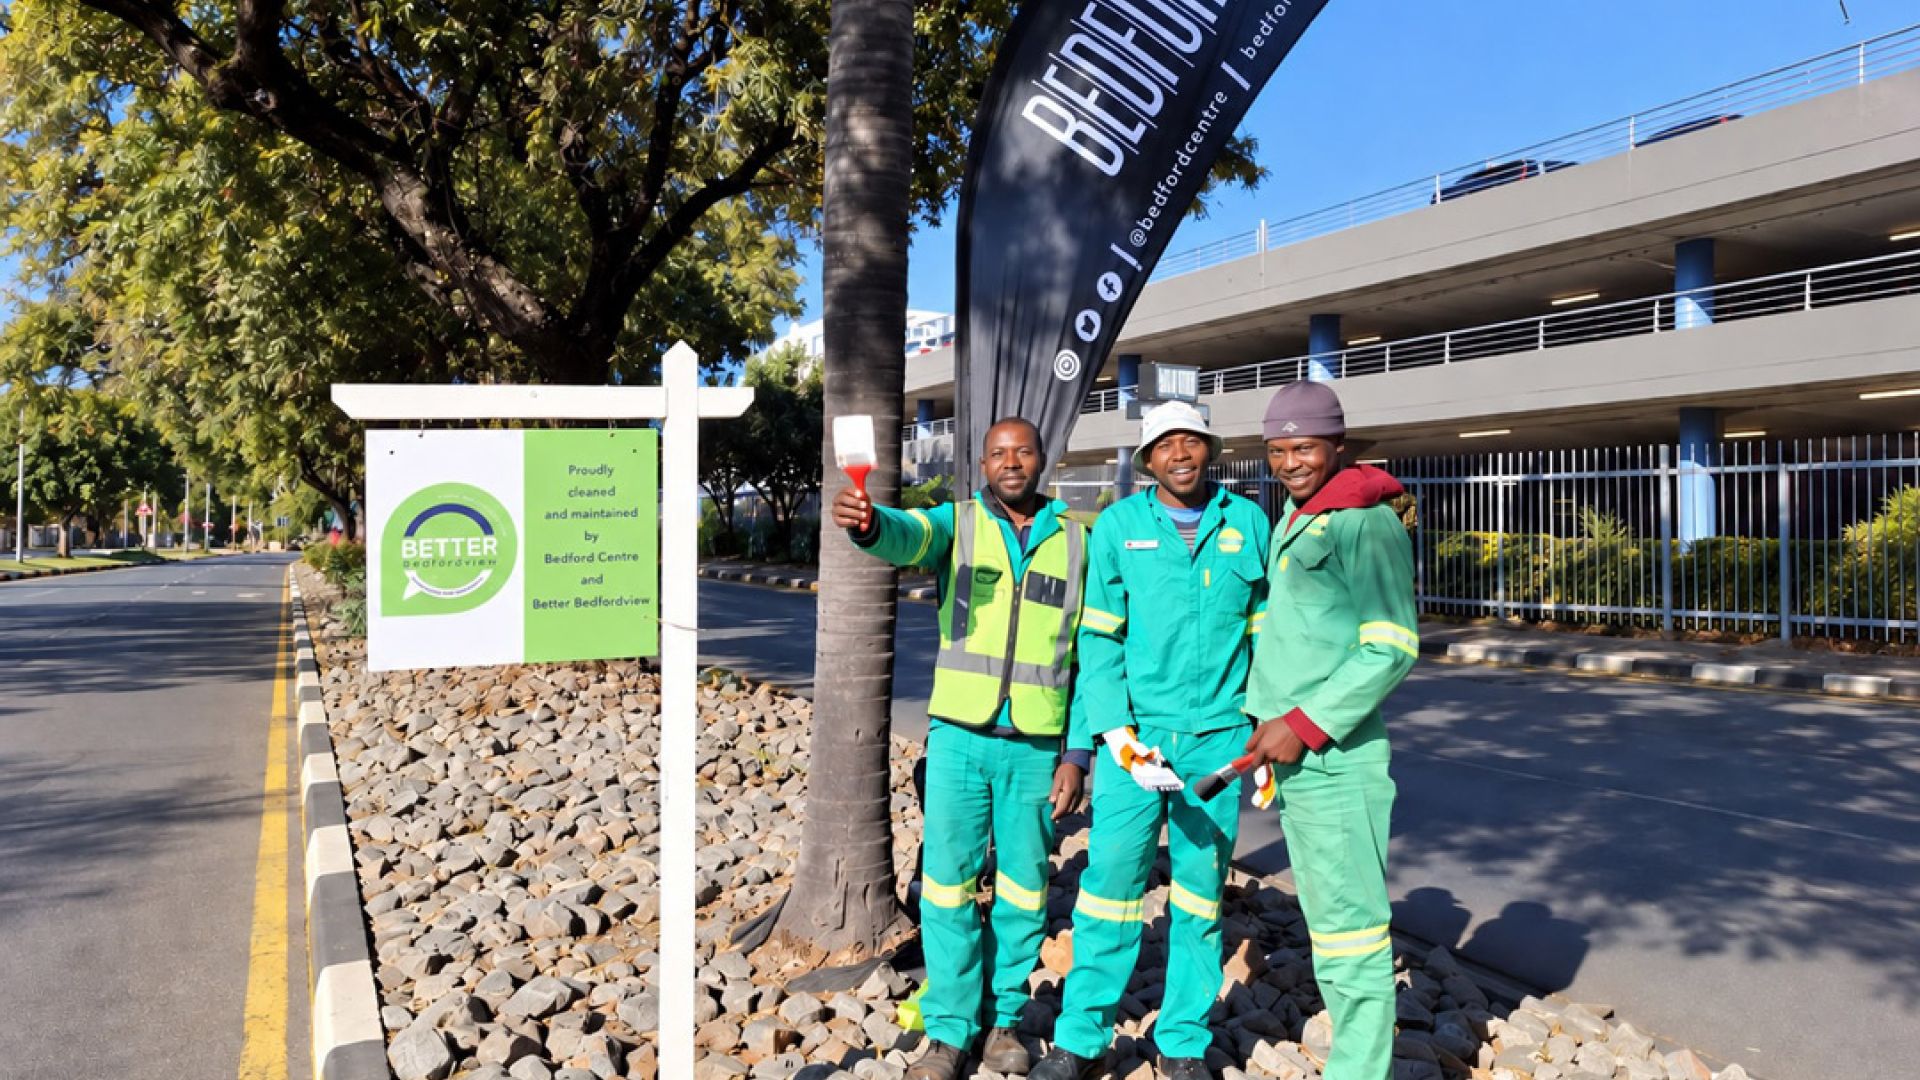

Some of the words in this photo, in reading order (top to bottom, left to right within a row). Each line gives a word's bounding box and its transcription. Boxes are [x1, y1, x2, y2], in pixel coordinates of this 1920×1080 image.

[1021, 0, 1228, 177] BEDFO
[1129, 91, 1228, 248] @bedfordcentre
[568, 463, 615, 479] Proudly
[567, 485, 616, 498] cleaned
[544, 508, 568, 520] and
[570, 507, 639, 520] maintained
[584, 530, 600, 544] by
[401, 537, 497, 559] BETTER
[543, 552, 595, 564] Bedford
[597, 551, 639, 563] Centre
[580, 573, 604, 586] and
[532, 598, 570, 610] Better
[573, 596, 651, 609] Bedfordview
